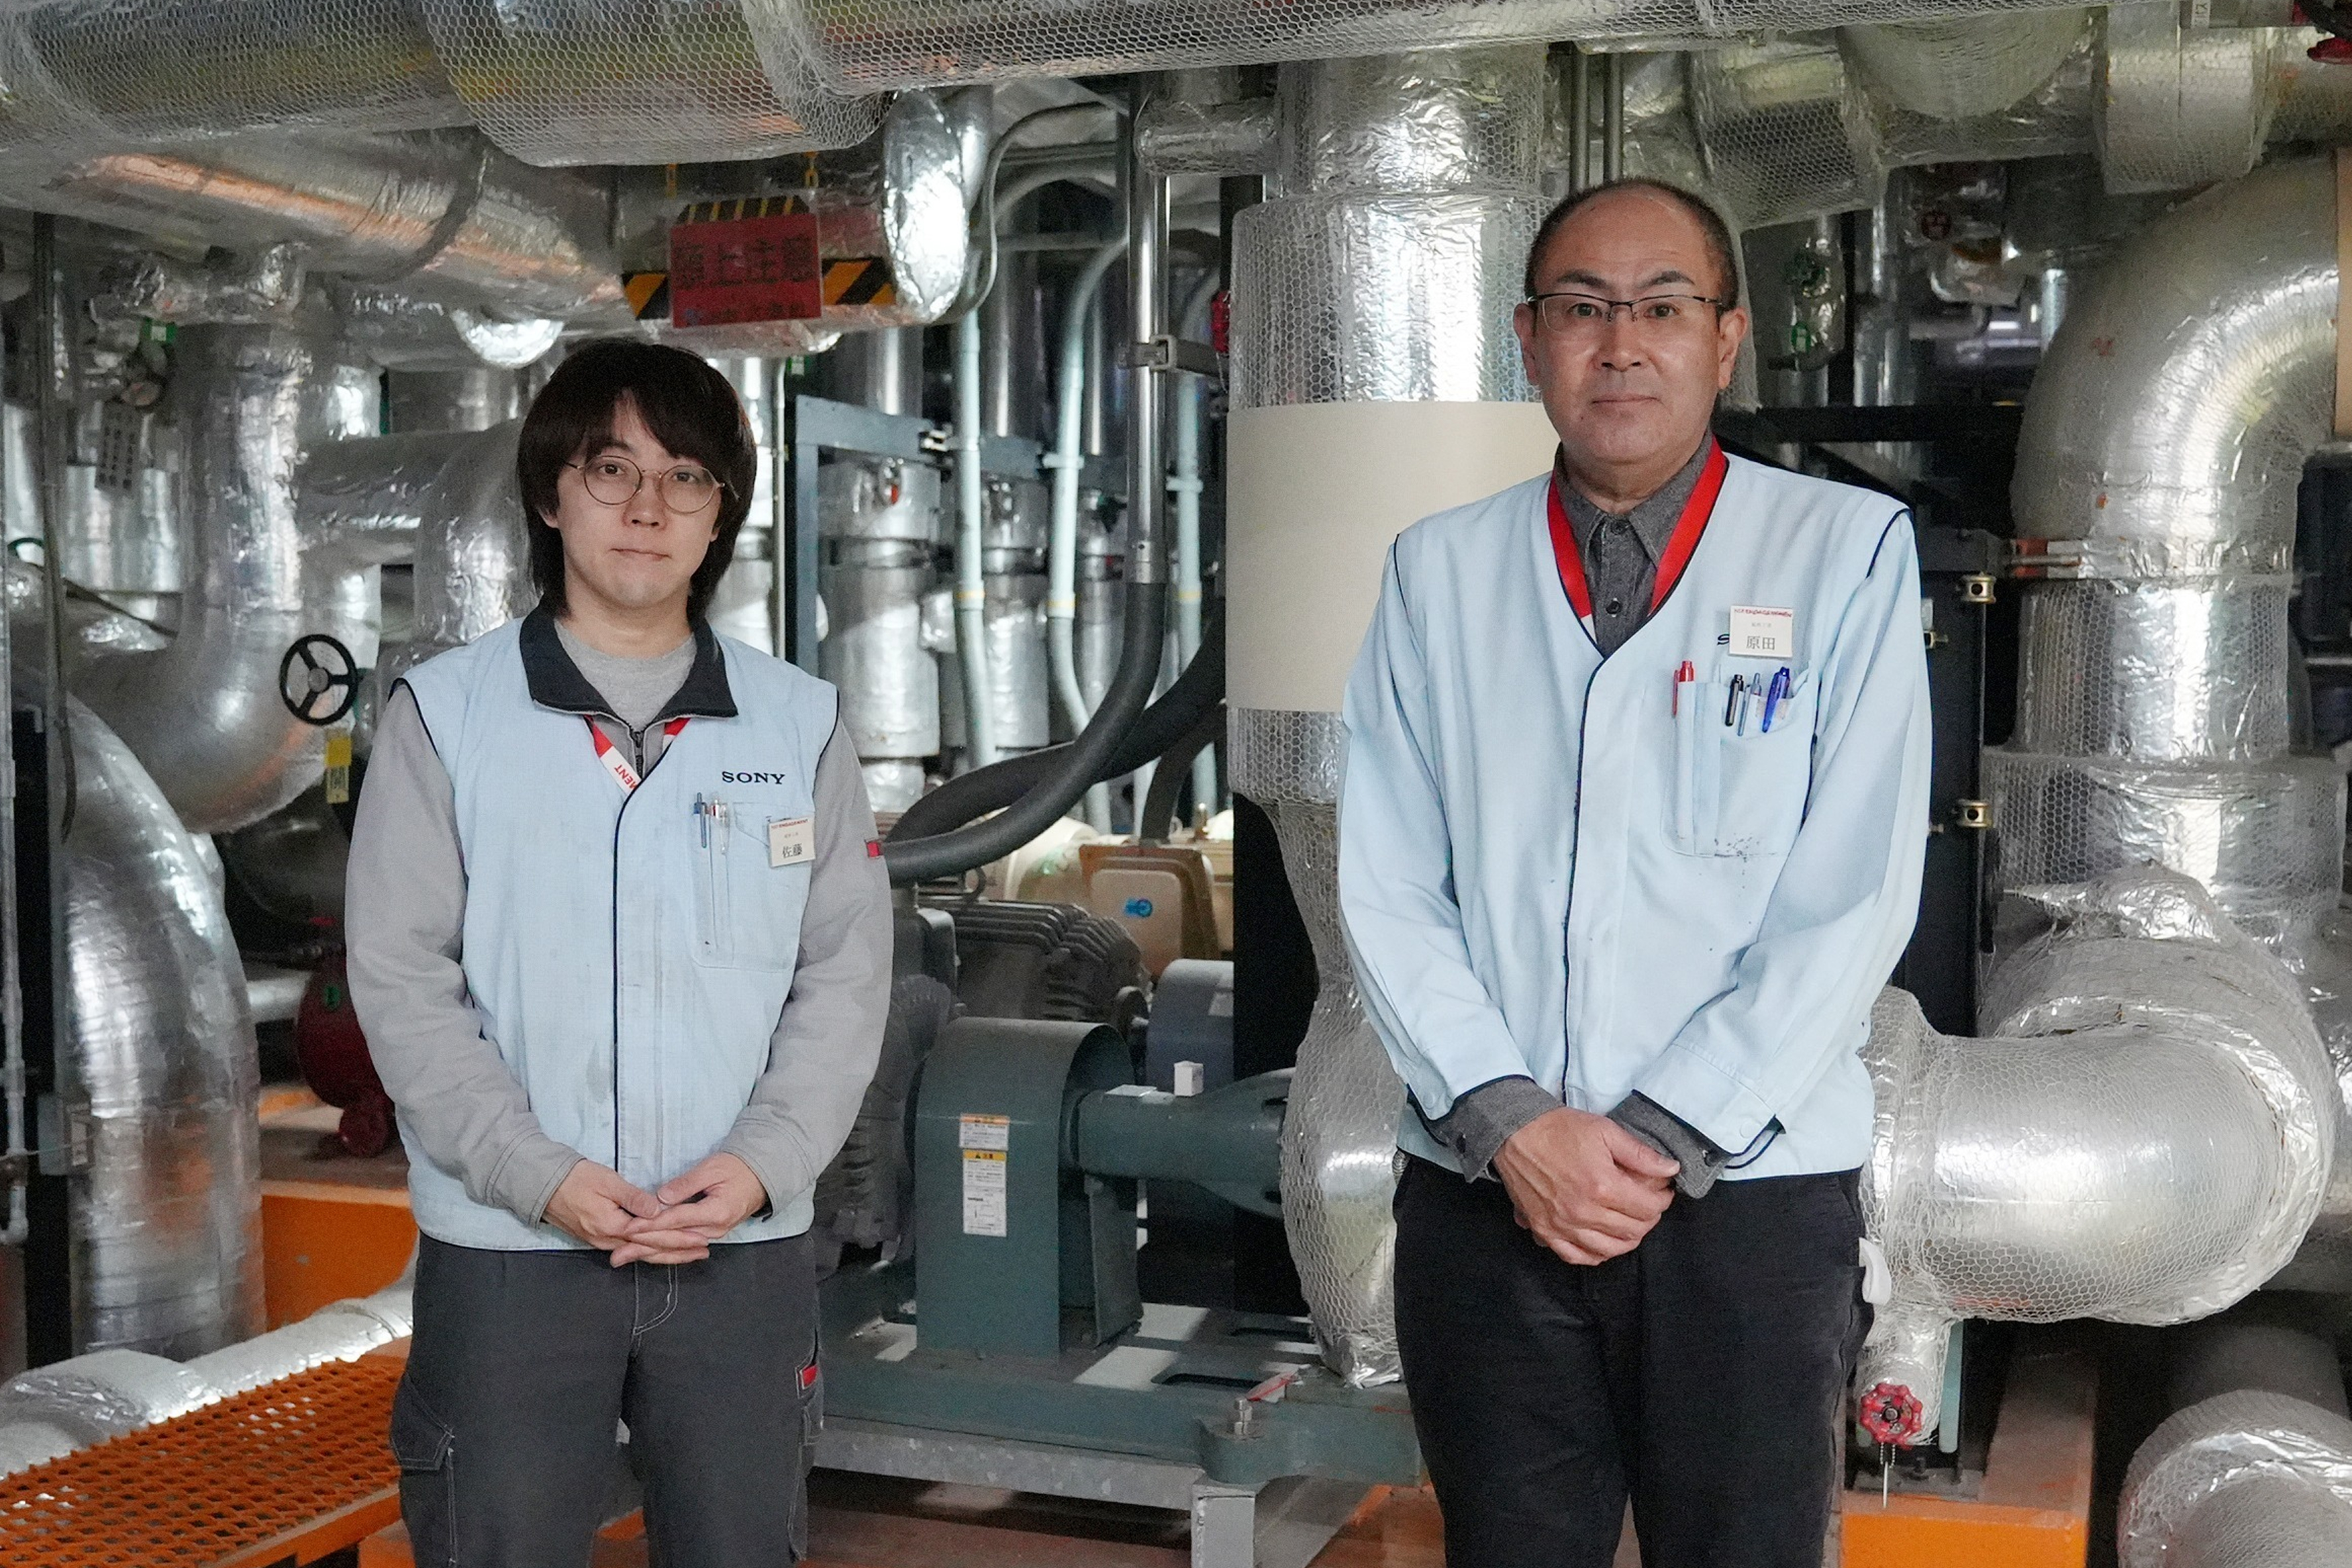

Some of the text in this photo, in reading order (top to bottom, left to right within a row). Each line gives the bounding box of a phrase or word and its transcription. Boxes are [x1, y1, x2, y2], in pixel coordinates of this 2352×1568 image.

[1747, 636, 1775, 650] 原田
[722, 771, 785, 785] SONY
[782, 843, 803, 859] 佐藤
